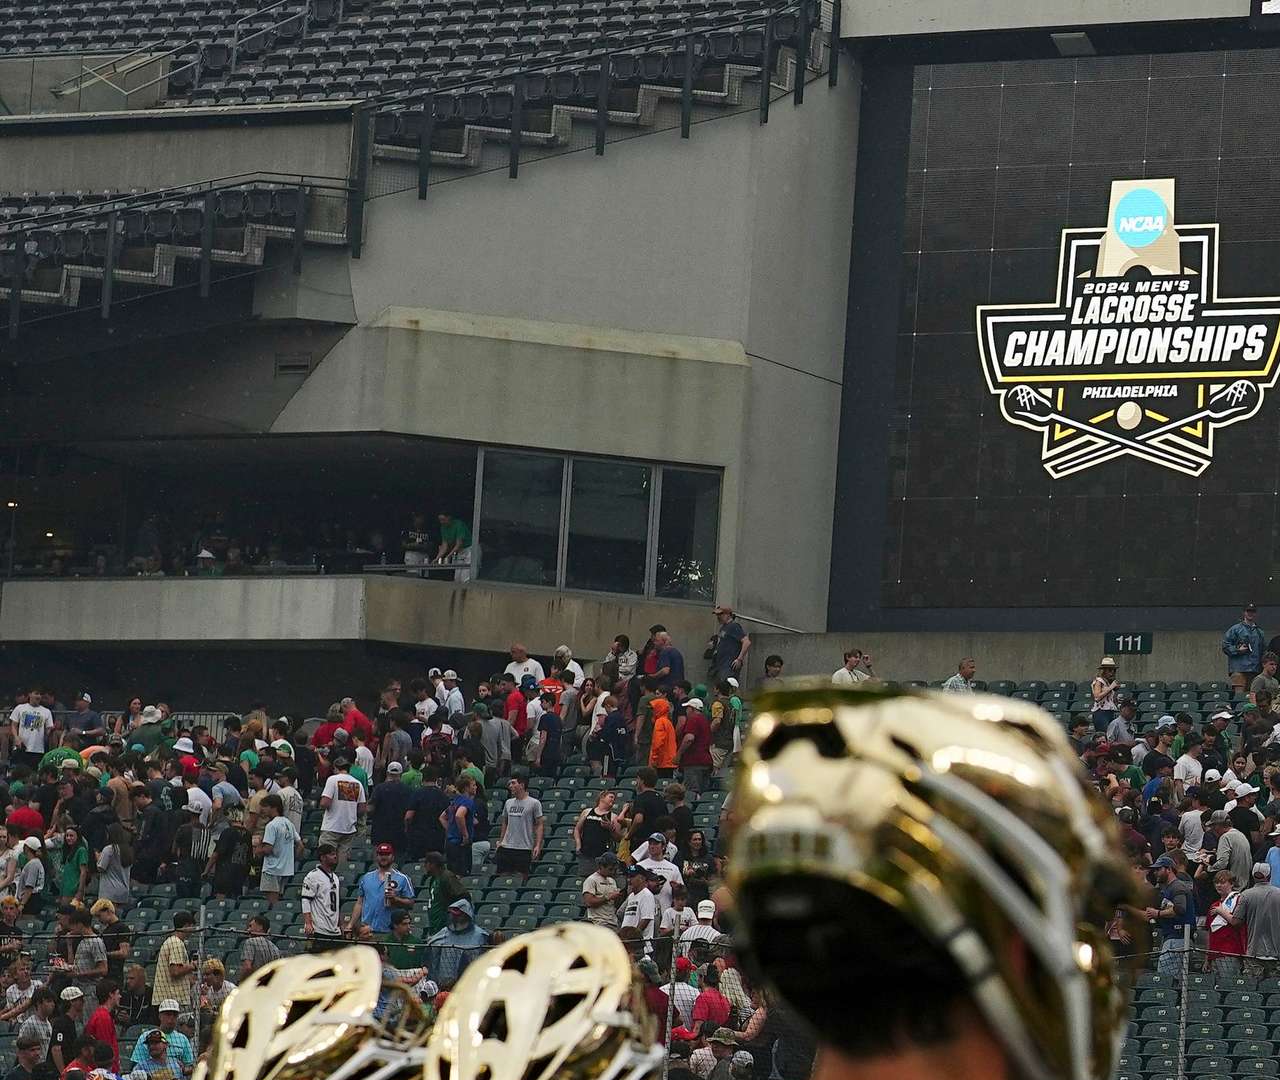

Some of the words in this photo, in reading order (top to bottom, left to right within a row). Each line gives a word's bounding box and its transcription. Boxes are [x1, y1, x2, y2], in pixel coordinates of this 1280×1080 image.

[1119, 215, 1164, 232] NCAA
[1083, 282, 1129, 295] 2024
[1134, 280, 1191, 293] MEN'S
[1070, 294, 1199, 325] LACROSSE
[1003, 324, 1268, 368] CHAMPIONSHIPS
[1082, 385, 1179, 399] PHILADELPHIA
[1115, 635, 1142, 651] 111
